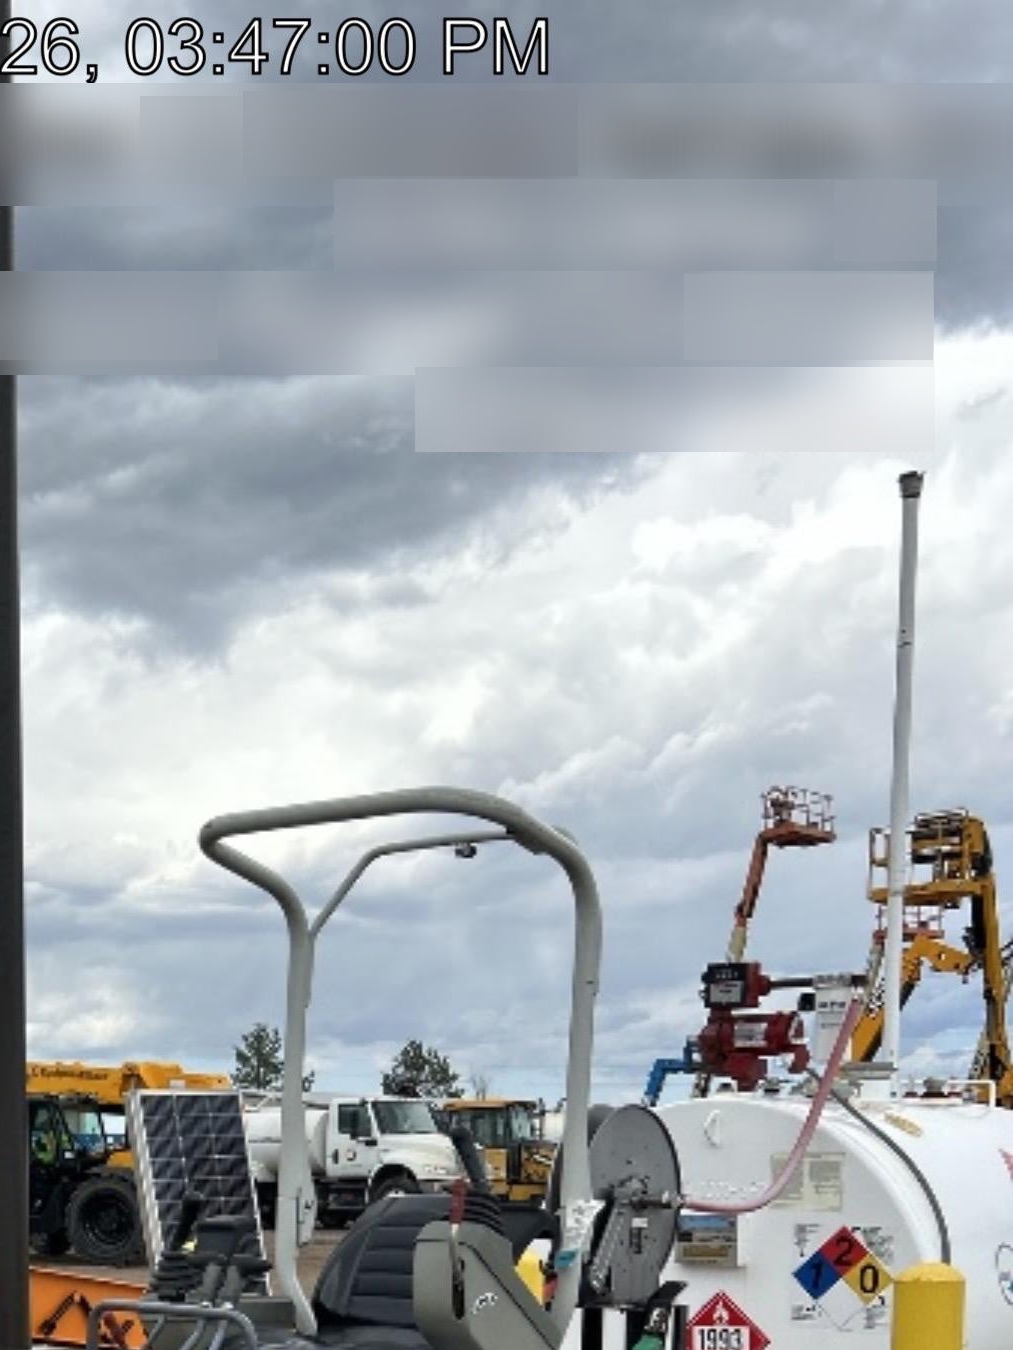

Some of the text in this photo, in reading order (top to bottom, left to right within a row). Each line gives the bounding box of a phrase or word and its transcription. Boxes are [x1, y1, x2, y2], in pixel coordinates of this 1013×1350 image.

[834, 1238, 855, 1266] 2
[811, 1262, 879, 1293] 1 0
